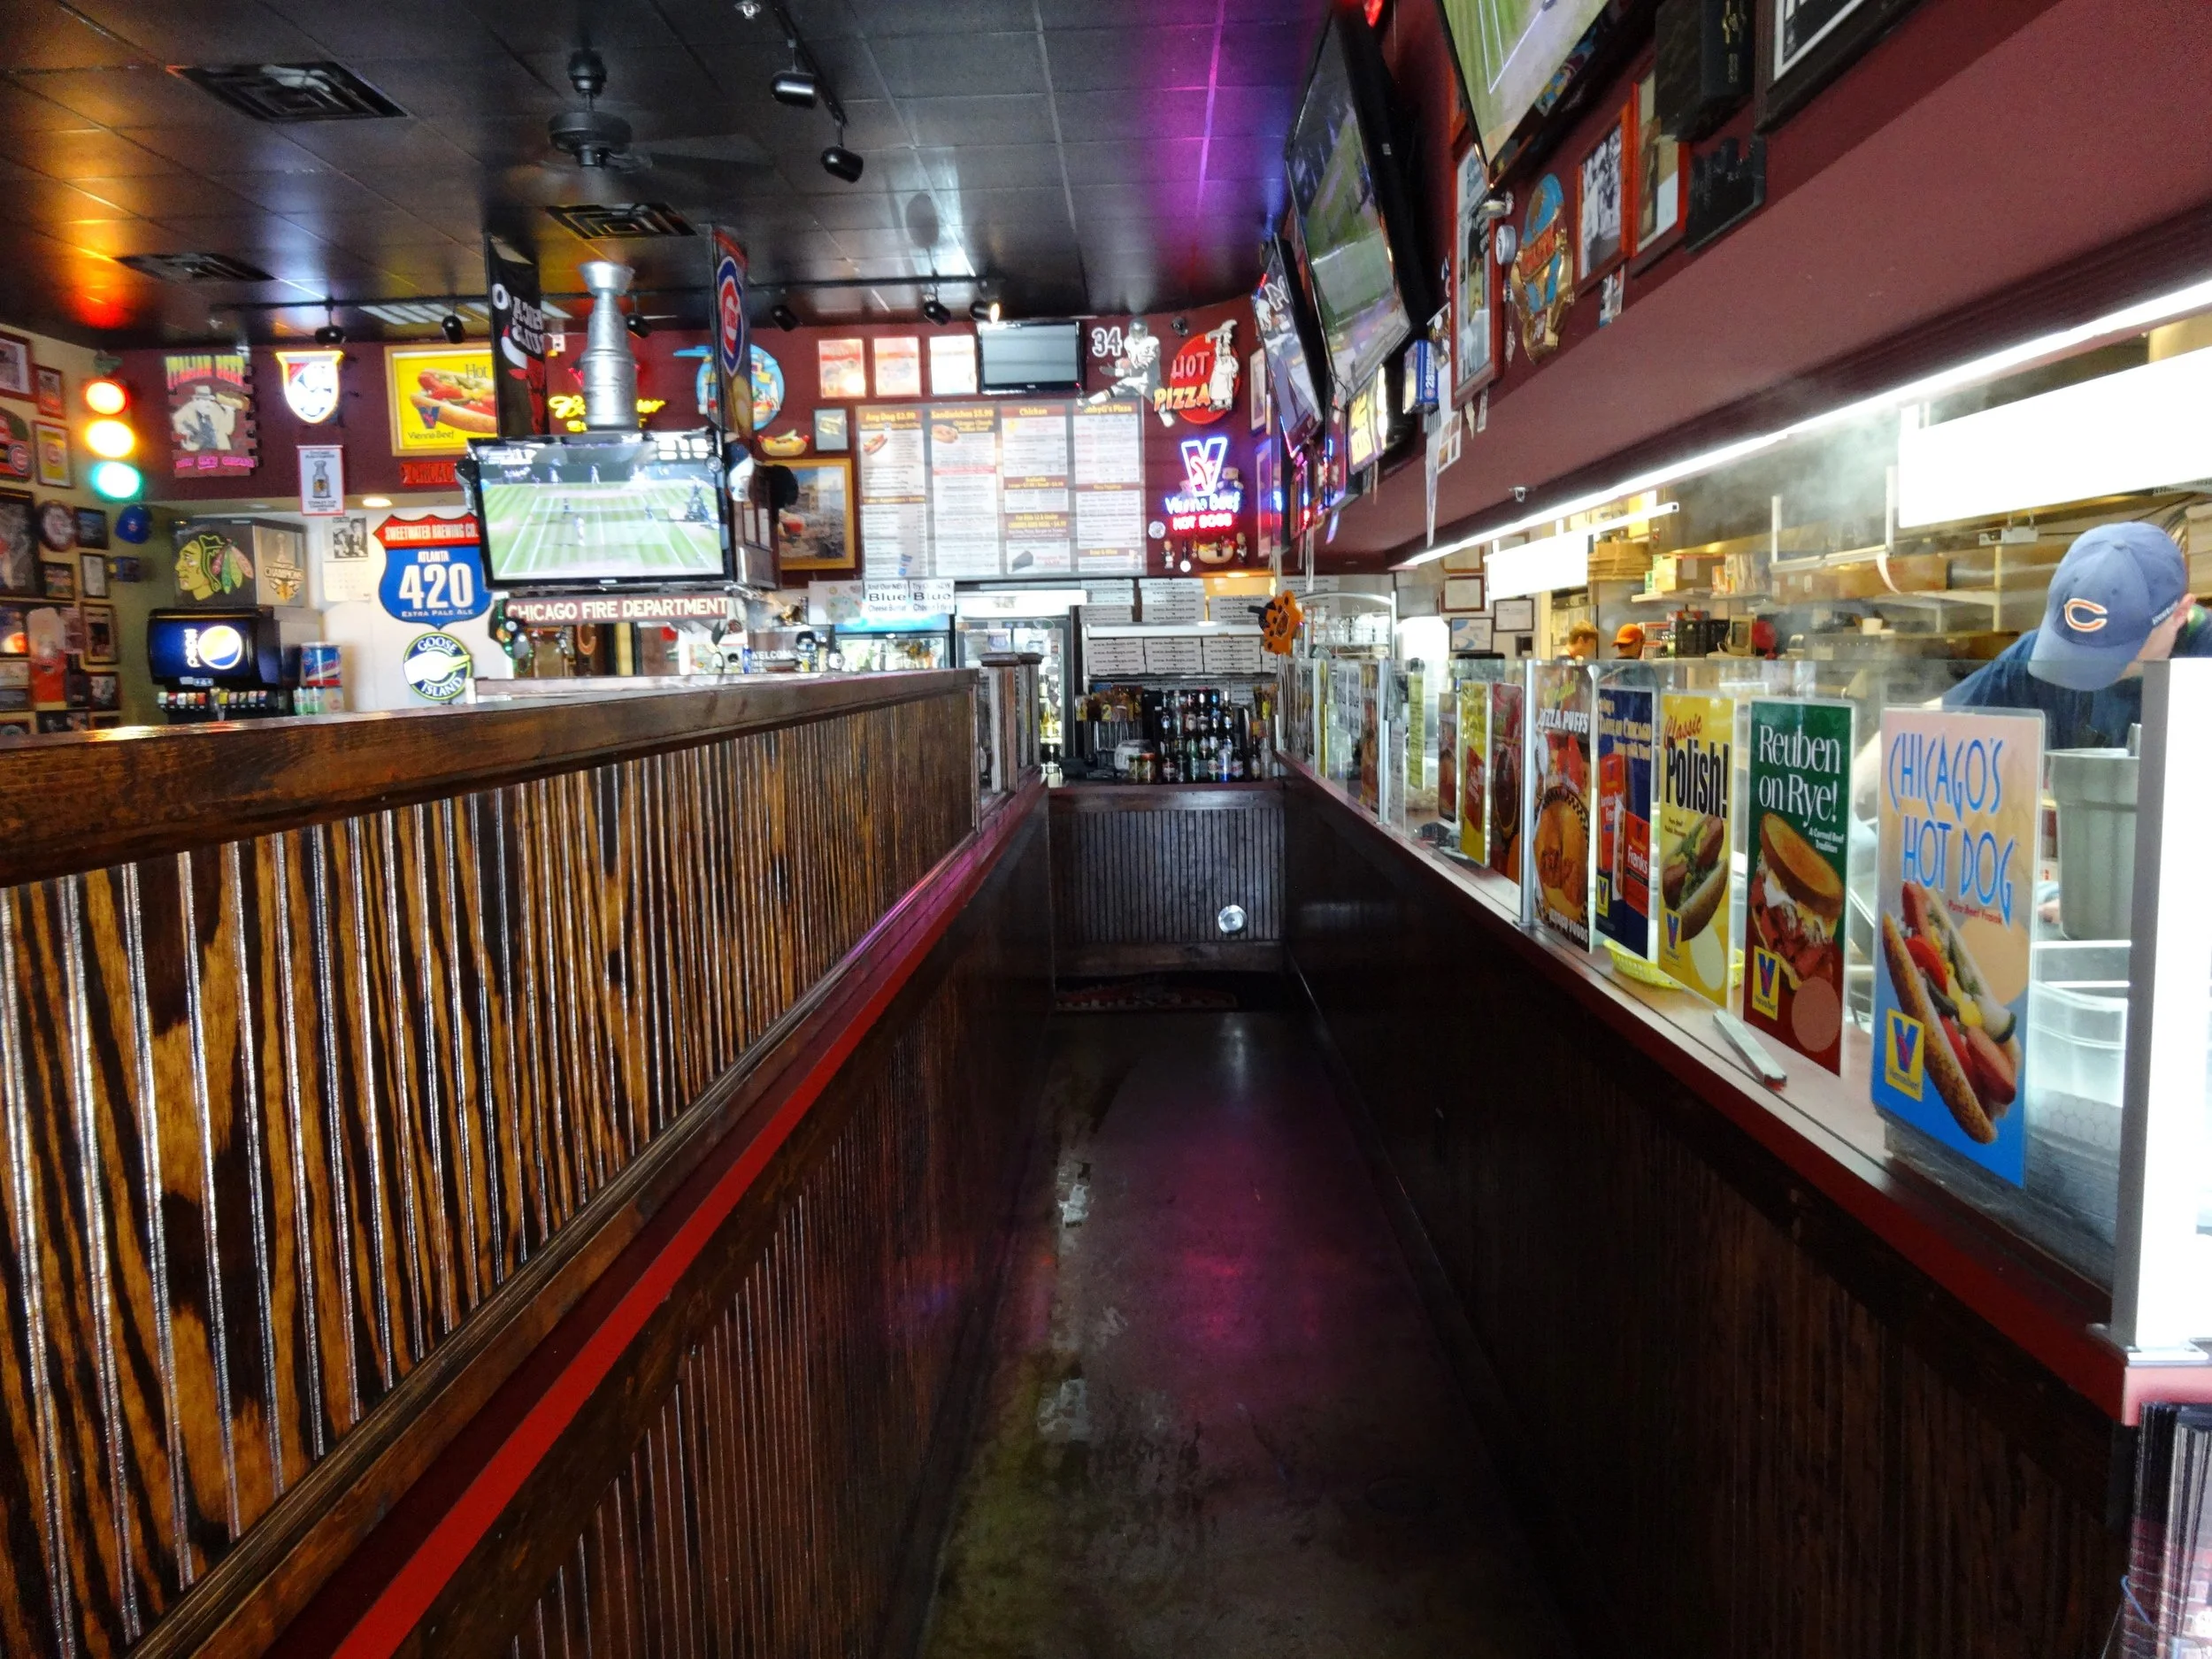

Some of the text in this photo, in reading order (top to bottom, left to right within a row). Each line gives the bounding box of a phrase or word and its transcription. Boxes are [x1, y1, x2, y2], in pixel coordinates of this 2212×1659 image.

[1091, 326, 1124, 357] 34
[465, 364, 488, 379] Hot
[1171, 350, 1210, 380] HOT
[1084, 405, 1112, 414] obbyG's
[1154, 382, 1211, 411] PIZZA
[1019, 407, 1048, 416] Chicken
[409, 462, 454, 484] CHICAG
[1172, 514, 1196, 531] HOT
[418, 550, 449, 563] ATLANTA
[398, 563, 474, 609] 420
[869, 593, 906, 602] Blue
[507, 597, 728, 621] CHICAGO FIRE DEPARTMENT
[417, 636, 457, 654] GOOSE
[421, 677, 463, 697] ISLAND
[1563, 710, 1589, 734] PUFFS
[1664, 712, 1702, 750] Classic
[1759, 725, 1841, 774] Reuben
[1666, 735, 1729, 818] Polish!
[1889, 733, 2004, 823] CHICAGO'S
[1759, 773, 1838, 828] on Rye!
[1627, 845, 1647, 874] Franks
[1902, 816, 2014, 927] HOT DOG
